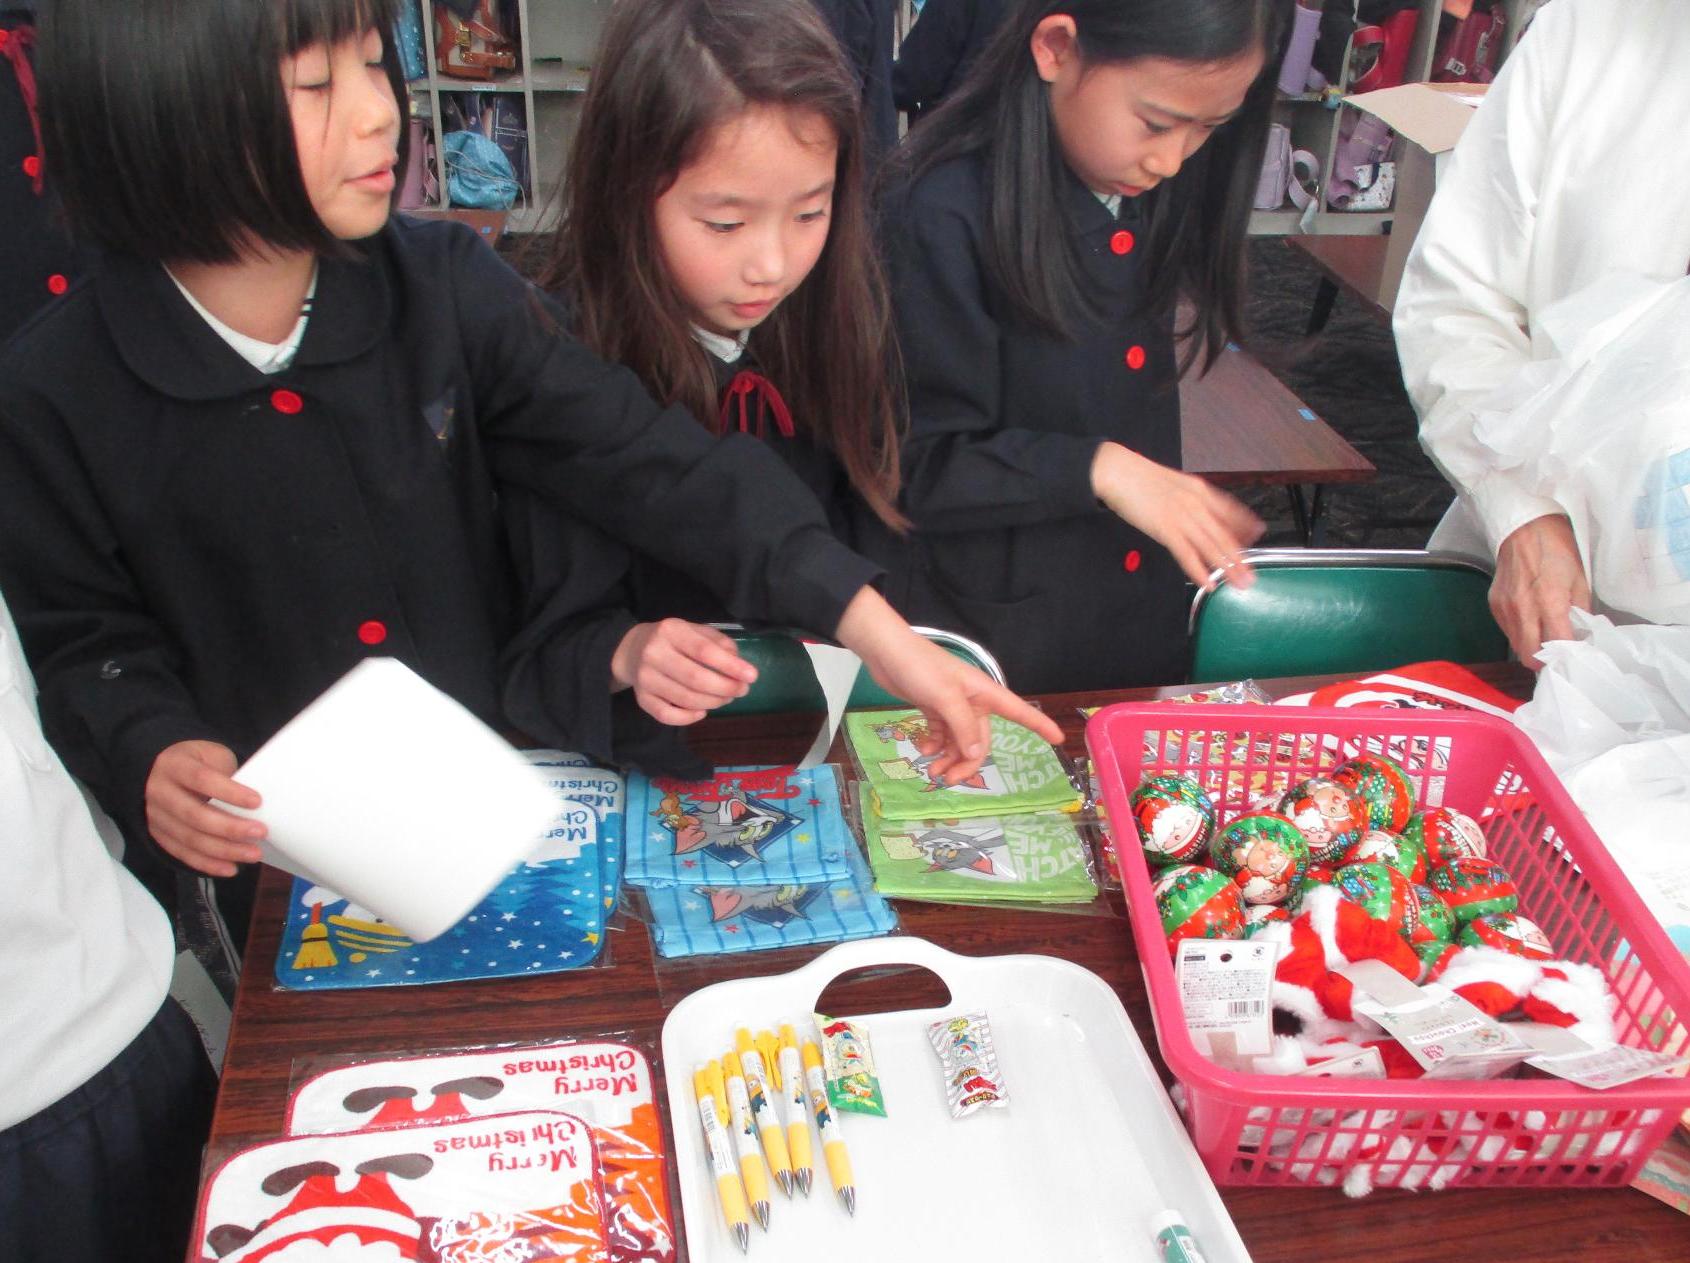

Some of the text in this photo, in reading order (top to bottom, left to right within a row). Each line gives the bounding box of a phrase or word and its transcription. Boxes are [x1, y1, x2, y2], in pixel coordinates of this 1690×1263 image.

[992, 751, 1038, 772] ME
[549, 779, 618, 794] Christ
[1001, 763, 1062, 793] TCH
[564, 794, 615, 808] Merr
[1006, 831, 1053, 855] ME
[504, 1049, 636, 1076] Christmas
[555, 1074, 638, 1097] Merry
[432, 1121, 577, 1154] Christmas
[487, 1146, 578, 1173] Merry
